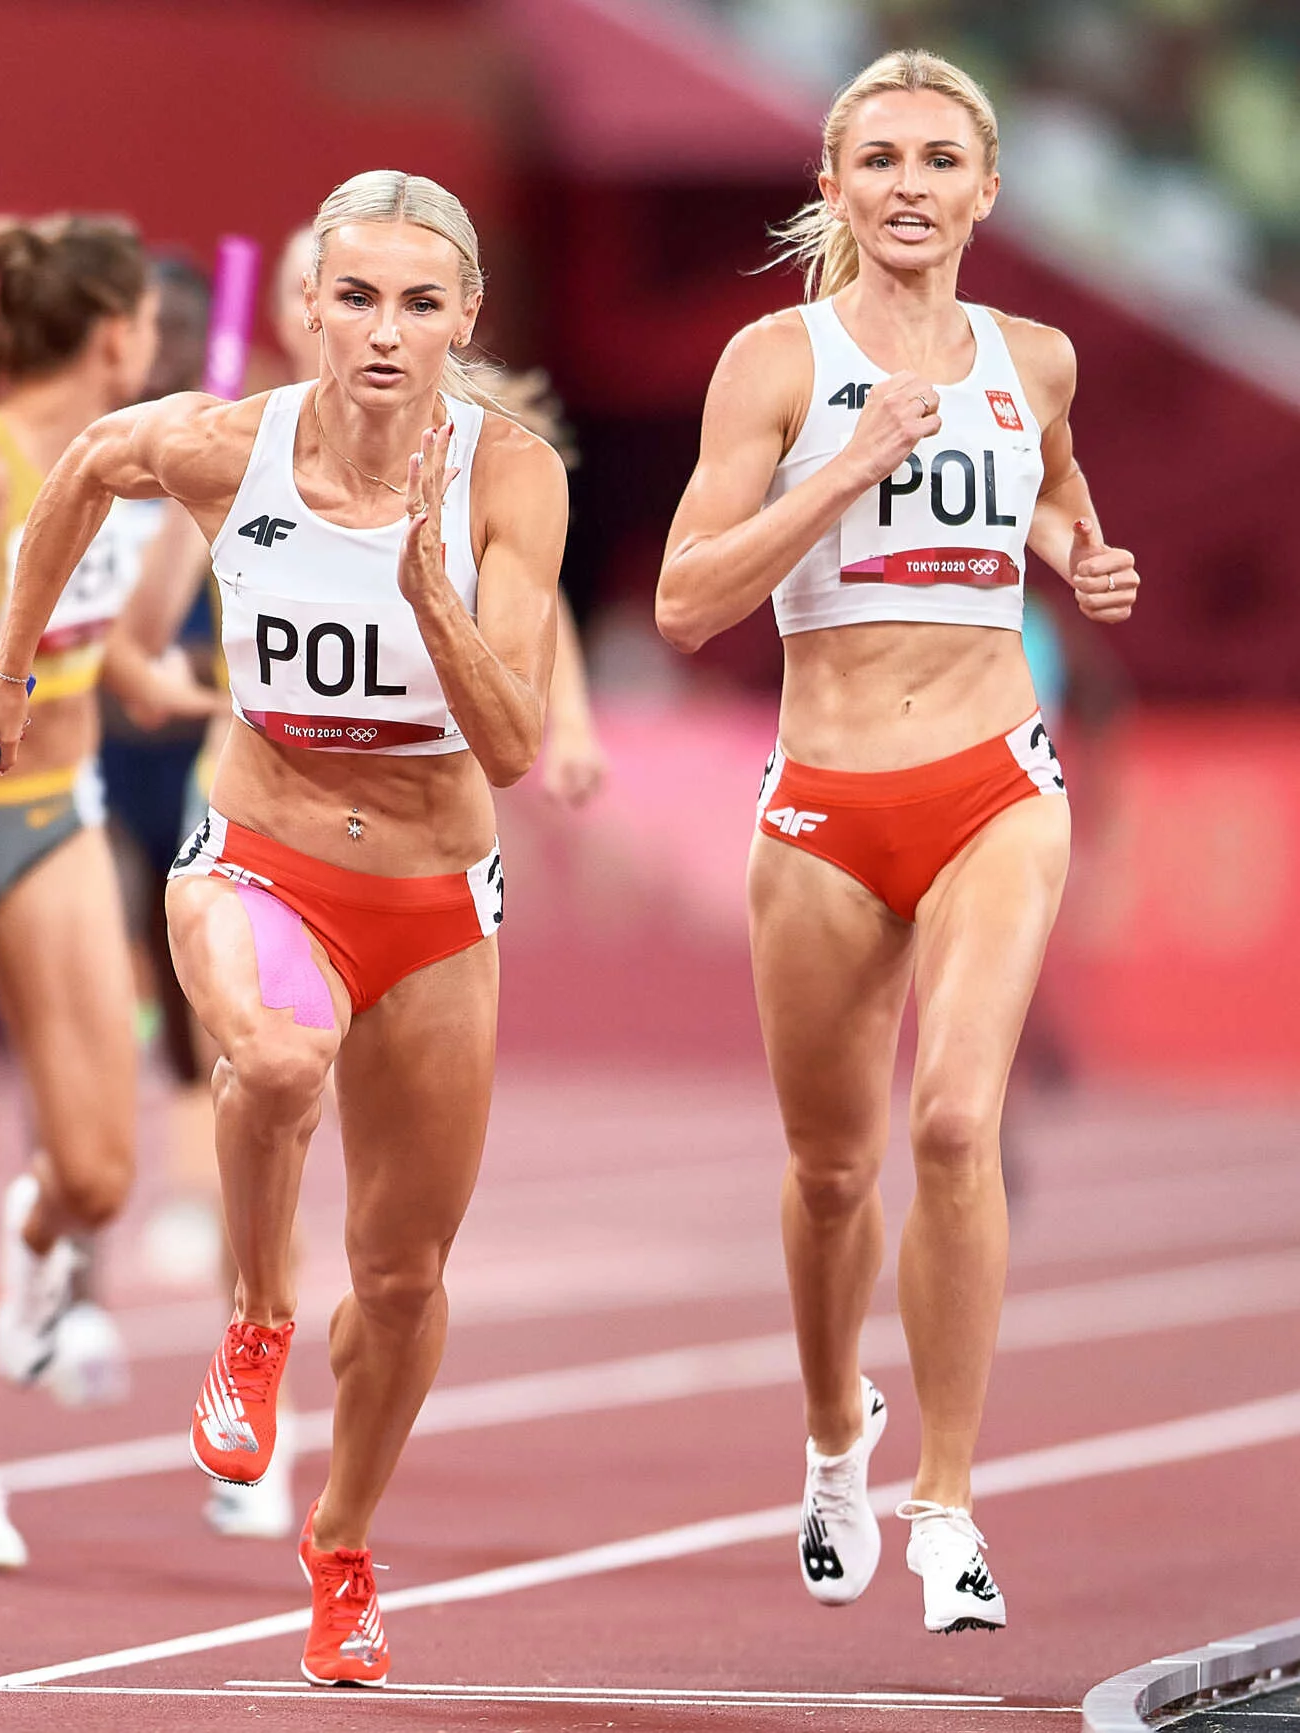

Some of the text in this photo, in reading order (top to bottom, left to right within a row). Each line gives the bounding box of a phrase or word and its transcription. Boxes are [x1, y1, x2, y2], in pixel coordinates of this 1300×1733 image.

[878, 450, 1017, 527] POL
[238, 515, 297, 548] 4F
[906, 561, 966, 572] TOKYO 2020
[256, 613, 407, 697] POL
[283, 723, 342, 738] TOKYO 2020
[766, 807, 828, 837] 4F
